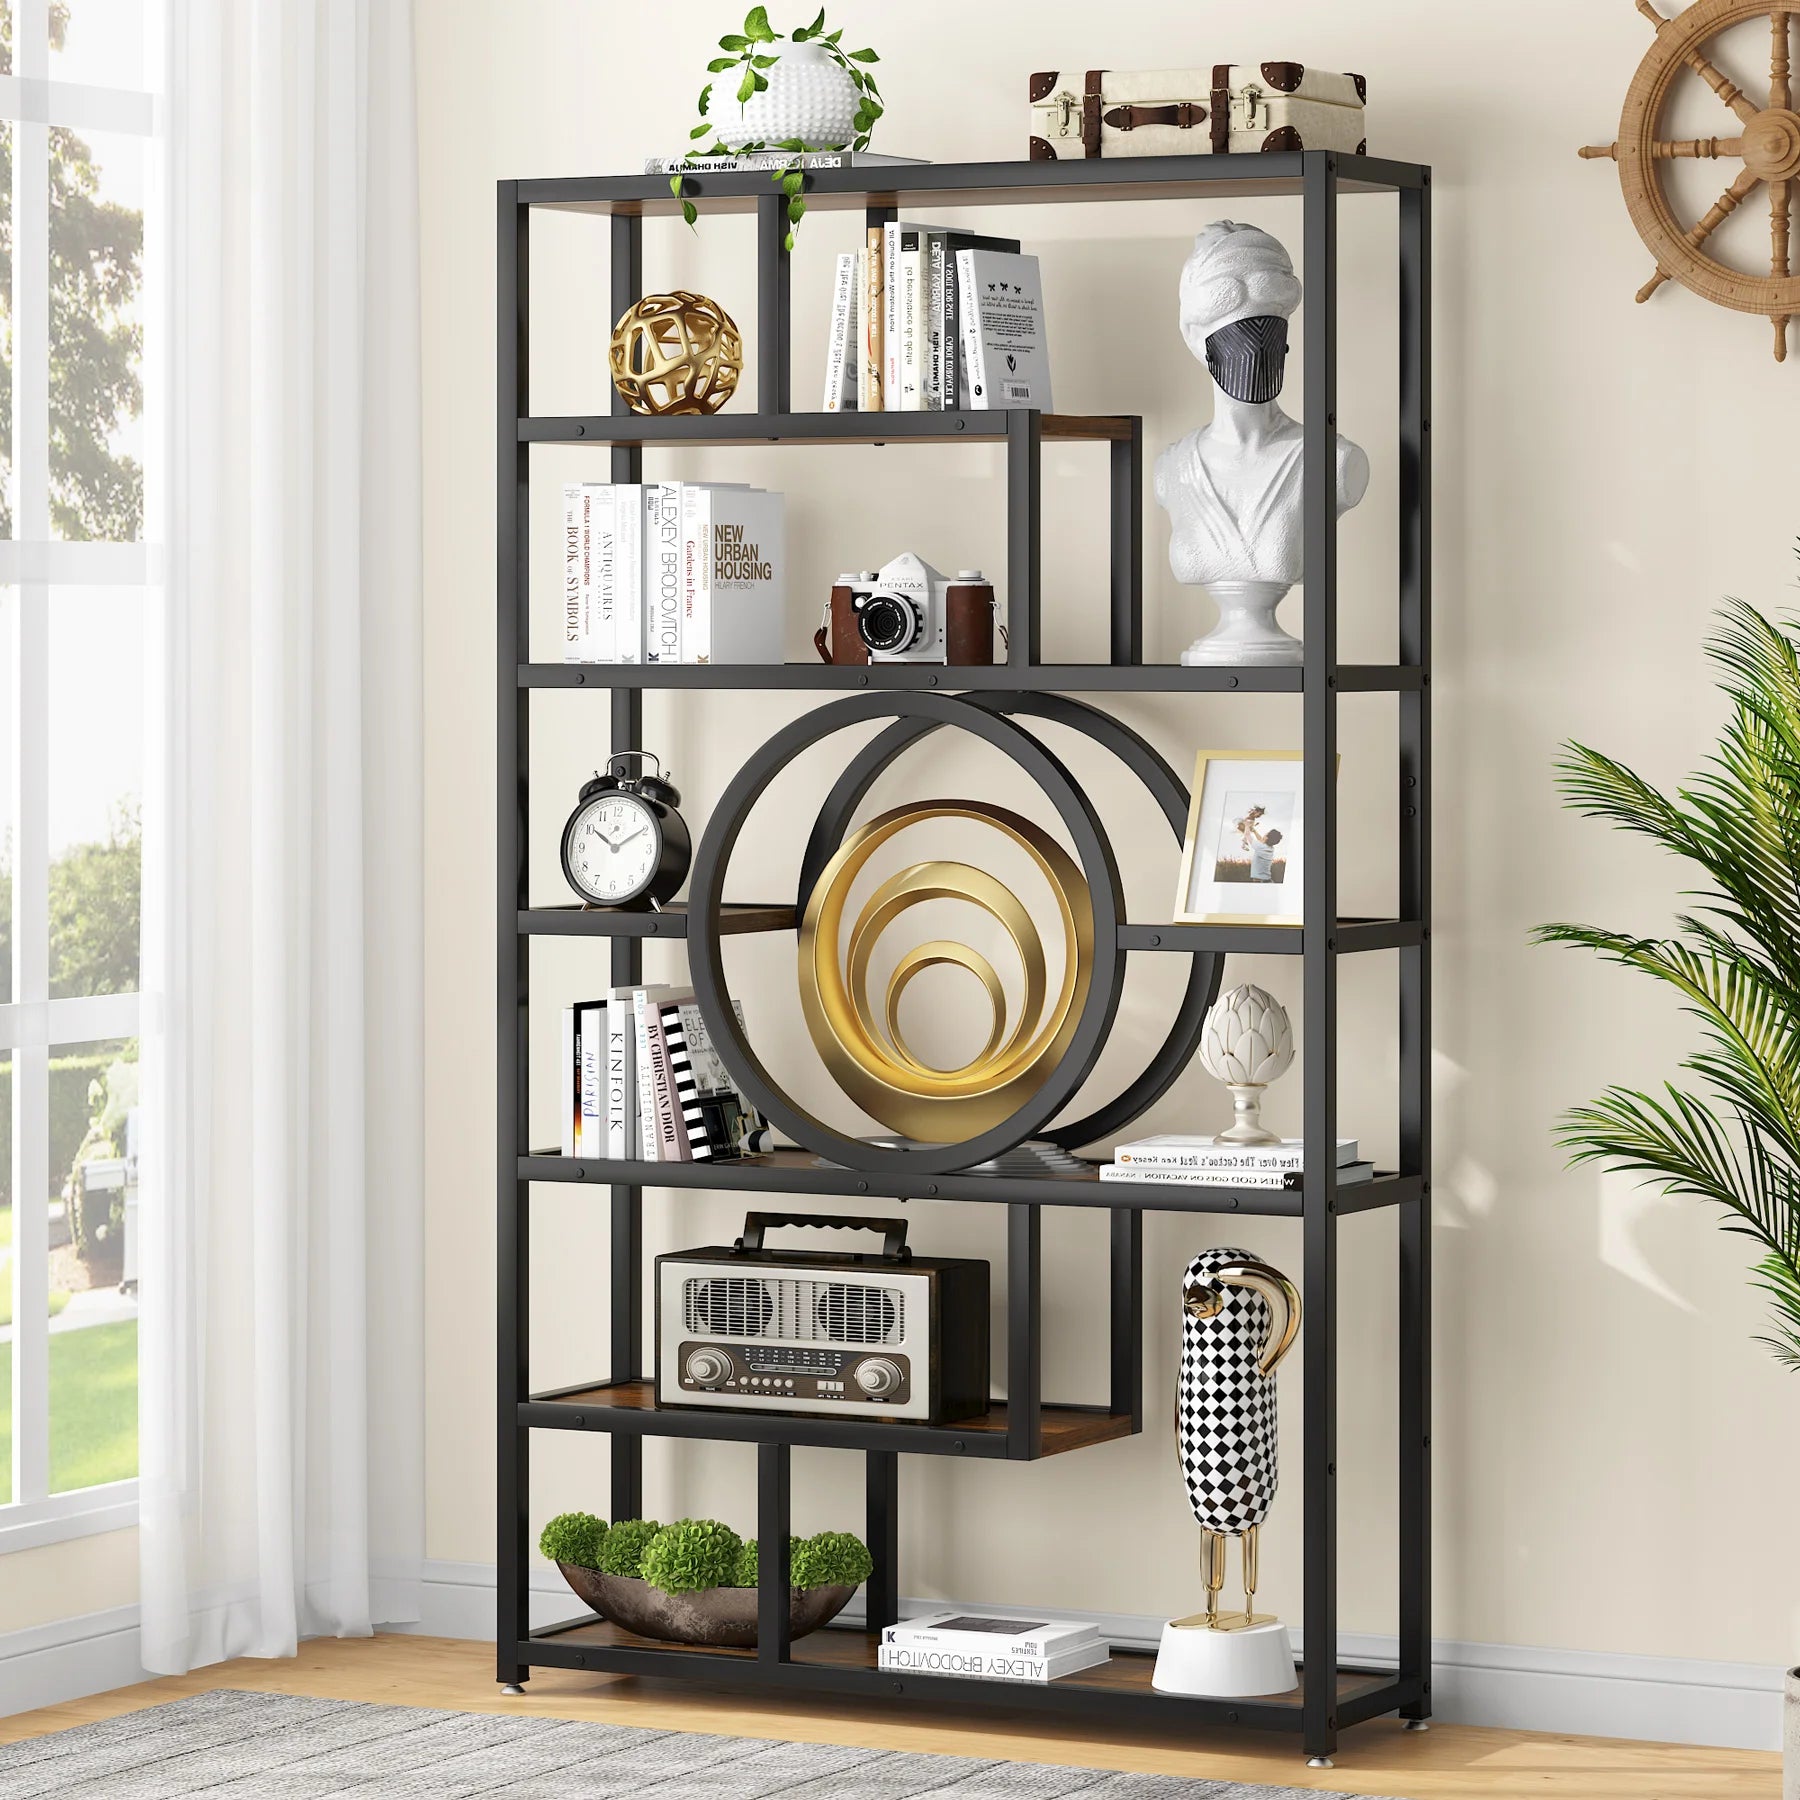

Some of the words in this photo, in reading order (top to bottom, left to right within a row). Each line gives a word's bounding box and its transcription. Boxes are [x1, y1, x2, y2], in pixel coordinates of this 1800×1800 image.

[661, 485, 677, 548] ALEXEY
[714, 524, 744, 542] NEW
[566, 526, 579, 563] BOOK
[714, 543, 759, 562] URBAN
[686, 540, 695, 577] Gardens
[601, 532, 613, 621] ANTIQUAIRES
[714, 562, 772, 580] HOUSING
[686, 578, 695, 587] in
[714, 581, 733, 590] HILARY
[734, 581, 755, 590] FRENCH
[566, 577, 579, 642] SYMBOLS
[661, 552, 677, 656] BRODOVITCH
[686, 589, 695, 619] France
[599, 810, 607, 822] 11
[613, 806, 624, 818] 12
[633, 811, 637, 822] 1
[586, 824, 595, 835] 10
[642, 824, 649, 836] 2
[578, 842, 586, 854] 9
[646, 844, 652, 855] 3
[582, 861, 589, 872] 8
[639, 862, 646, 874] 4
[594, 874, 601, 886] 7
[609, 880, 616, 892] 6
[627, 875, 634, 886] 5
[647, 1024, 659, 1042] BY
[688, 1032, 704, 1047] OF
[583, 1052, 600, 1117] PARISIAN
[610, 1033, 623, 1132] KINFOLK
[650, 1043, 670, 1109] CHRISTIAN
[641, 1064, 655, 1156] TRANQUILITY
[661, 1112, 675, 1144] DIOR
[889, 1649, 982, 1673] BRODOVITCH
[988, 1658, 1044, 1677] ALEXEY
